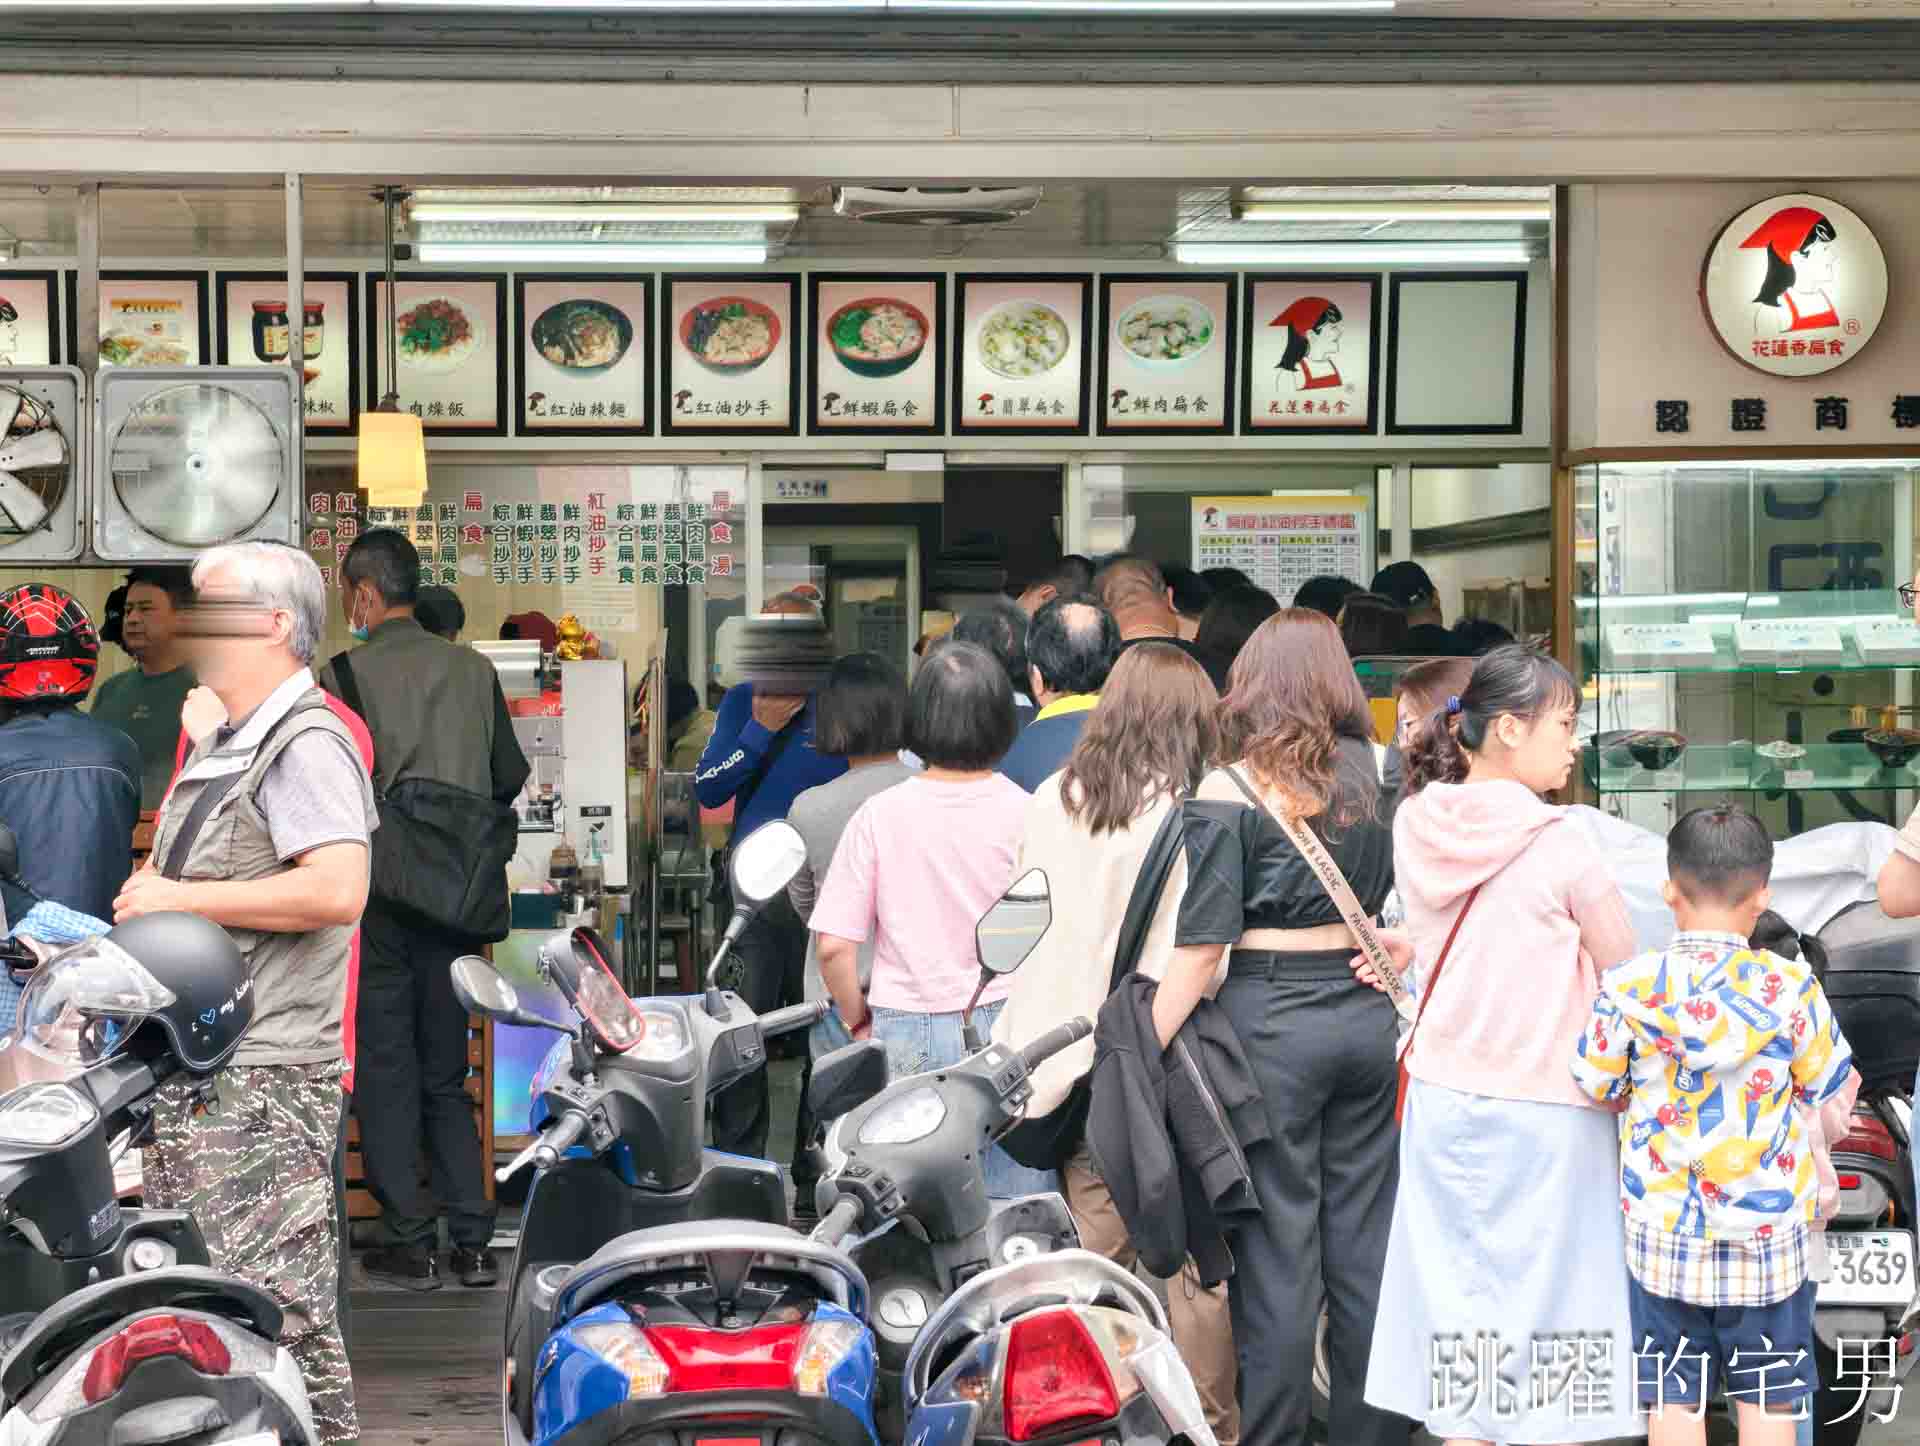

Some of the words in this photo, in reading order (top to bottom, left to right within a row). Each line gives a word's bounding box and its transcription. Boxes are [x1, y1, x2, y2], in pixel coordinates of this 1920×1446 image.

[1752, 339, 1845, 357] 花蓮香扁食
[695, 399, 771, 417] 紅油抄手
[843, 399, 919, 417] 鮮蝦扁食
[1133, 396, 1209, 413] 鮮肉扁食
[440, 504, 457, 584] 鮮肉扁食
[464, 490, 482, 544] 扁食
[493, 504, 510, 584] 綜合抄手
[517, 504, 534, 584] 鮮蝦抄手
[540, 504, 558, 584] 翡翠抄手
[563, 504, 580, 584] 鮮肉抄手
[587, 492, 607, 576] 紅油抄手
[616, 504, 635, 584] 綜合扁食
[640, 504, 657, 584] 鮮蝦扁食
[663, 504, 681, 584] 翡翠扁食
[687, 504, 705, 584] 鮮肉扁食
[711, 490, 733, 576] 扁食湯
[1820, 1249, 1907, 1285] -3639
